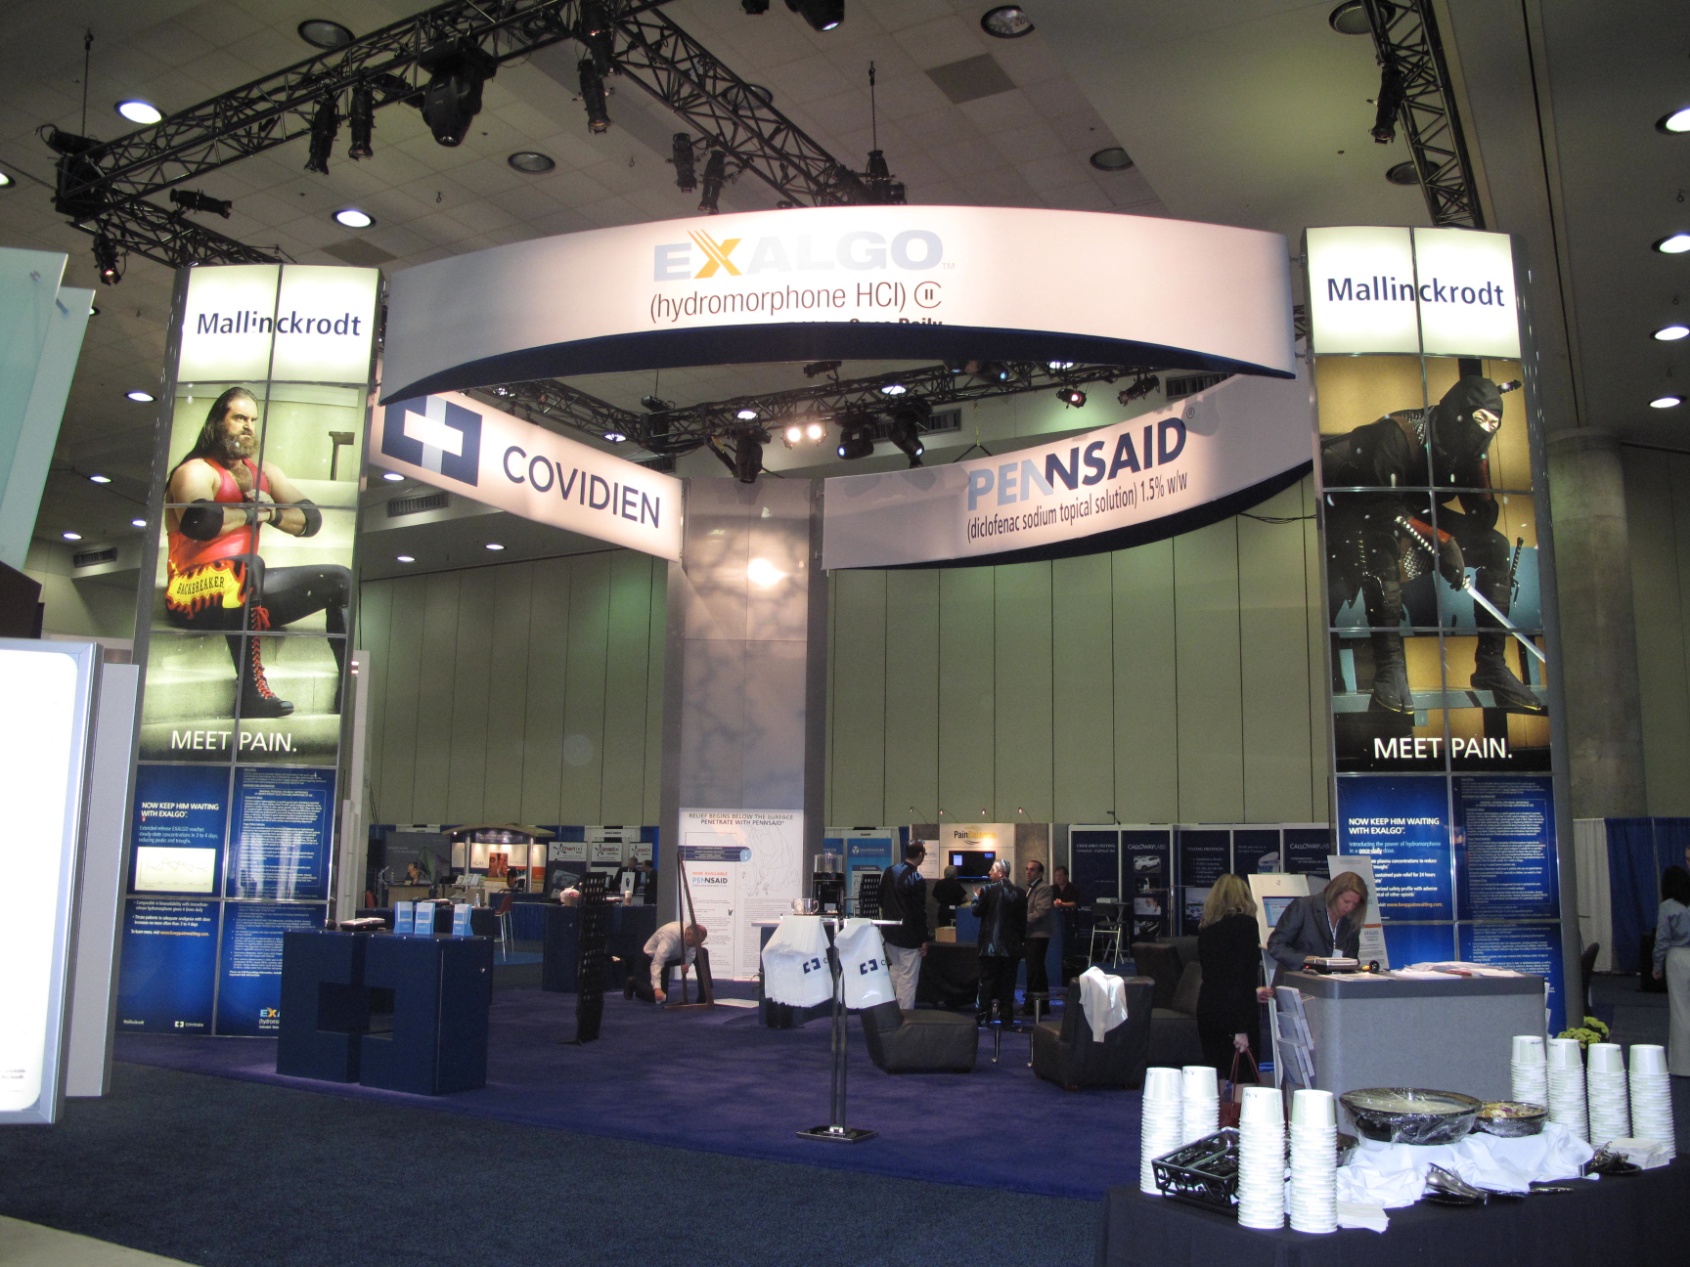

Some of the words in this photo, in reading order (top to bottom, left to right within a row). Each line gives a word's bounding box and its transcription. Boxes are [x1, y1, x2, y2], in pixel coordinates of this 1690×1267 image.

[653, 228, 944, 282] EXALGO
[650, 285, 846, 324] (hydromorphone
[1327, 275, 1505, 307] Mallinckrodt
[197, 310, 362, 336] Mallinckrodt
[967, 416, 1187, 511] PENNSAID
[503, 445, 660, 529] COVIDIEN
[967, 513, 1020, 543] (diclofenac
[1022, 505, 1057, 530] sodium
[1059, 495, 1092, 525] topical
[1095, 482, 1138, 513] solution)
[1140, 475, 1165, 502] 1.5%
[1167, 470, 1188, 495] w/w
[176, 575, 225, 595] BACKBREAKER
[171, 730, 232, 750] MEET
[239, 731, 297, 752] PAIN.
[1374, 737, 1442, 759] MEET
[1452, 738, 1513, 759] PAIN.
